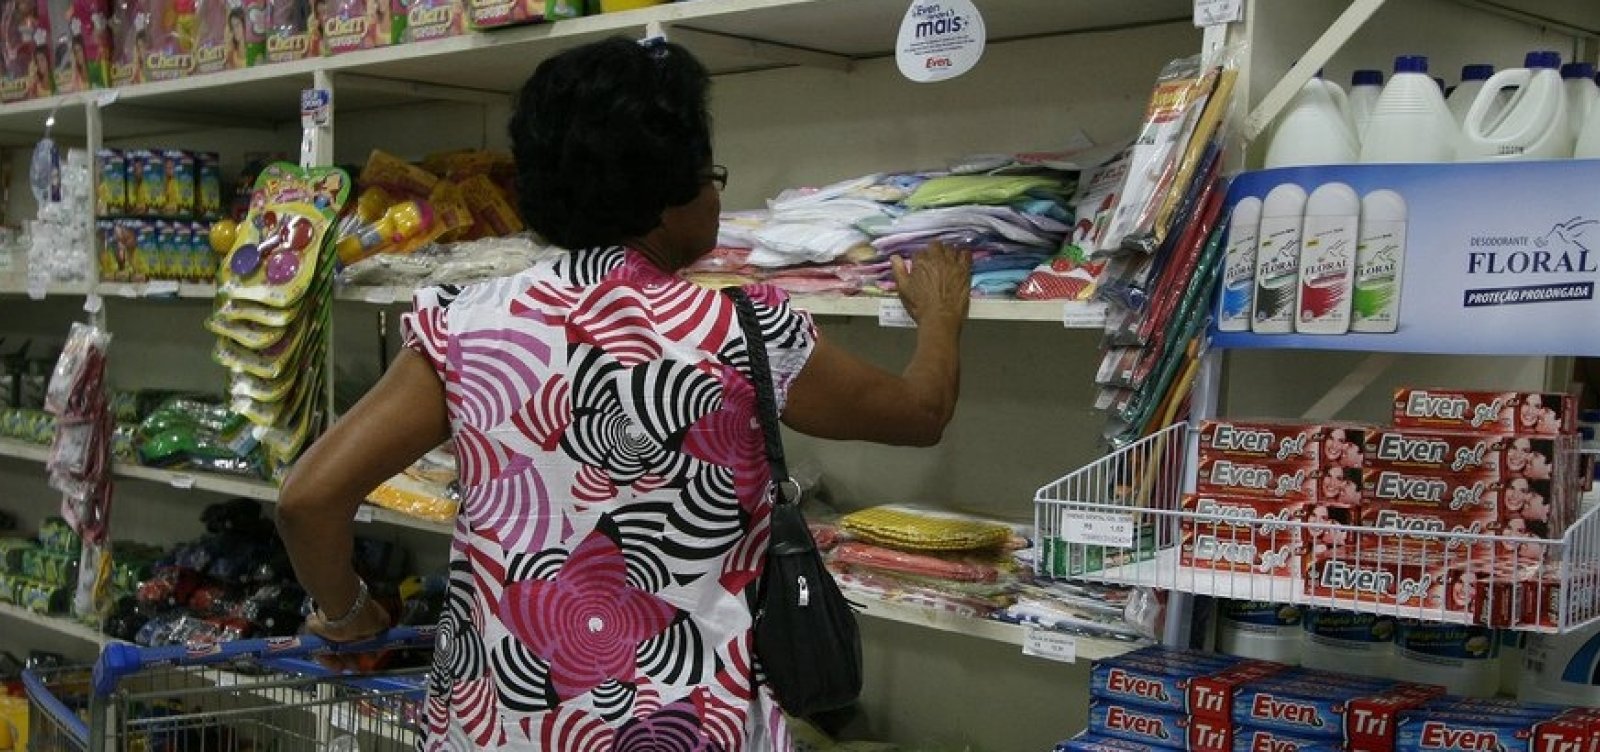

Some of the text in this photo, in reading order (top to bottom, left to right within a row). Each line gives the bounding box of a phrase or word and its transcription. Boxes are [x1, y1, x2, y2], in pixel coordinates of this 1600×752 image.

[325, 15, 368, 39] Cherry
[408, 4, 452, 28] Cherry
[915, 16, 961, 37] mais
[267, 34, 310, 57] Cherry
[147, 50, 198, 76] Cherry
[1467, 250, 1598, 274] FLORAL
[1520, 286, 1589, 300] PROLONGADA
[1406, 390, 1501, 428] Even gel
[1212, 423, 1306, 460] Even gel
[1378, 432, 1487, 472] Even gel
[1210, 460, 1305, 497] Even gel
[1376, 471, 1485, 511] Even gel
[1194, 534, 1257, 564] Even
[1320, 559, 1394, 594] Even
[1107, 667, 1164, 699] Even
[1195, 686, 1225, 712] Tri
[1252, 692, 1317, 726] Even
[1106, 705, 1164, 738] Even
[1354, 709, 1388, 737] Tri
[1420, 720, 1499, 752] Even
[1195, 724, 1226, 750] Tri
